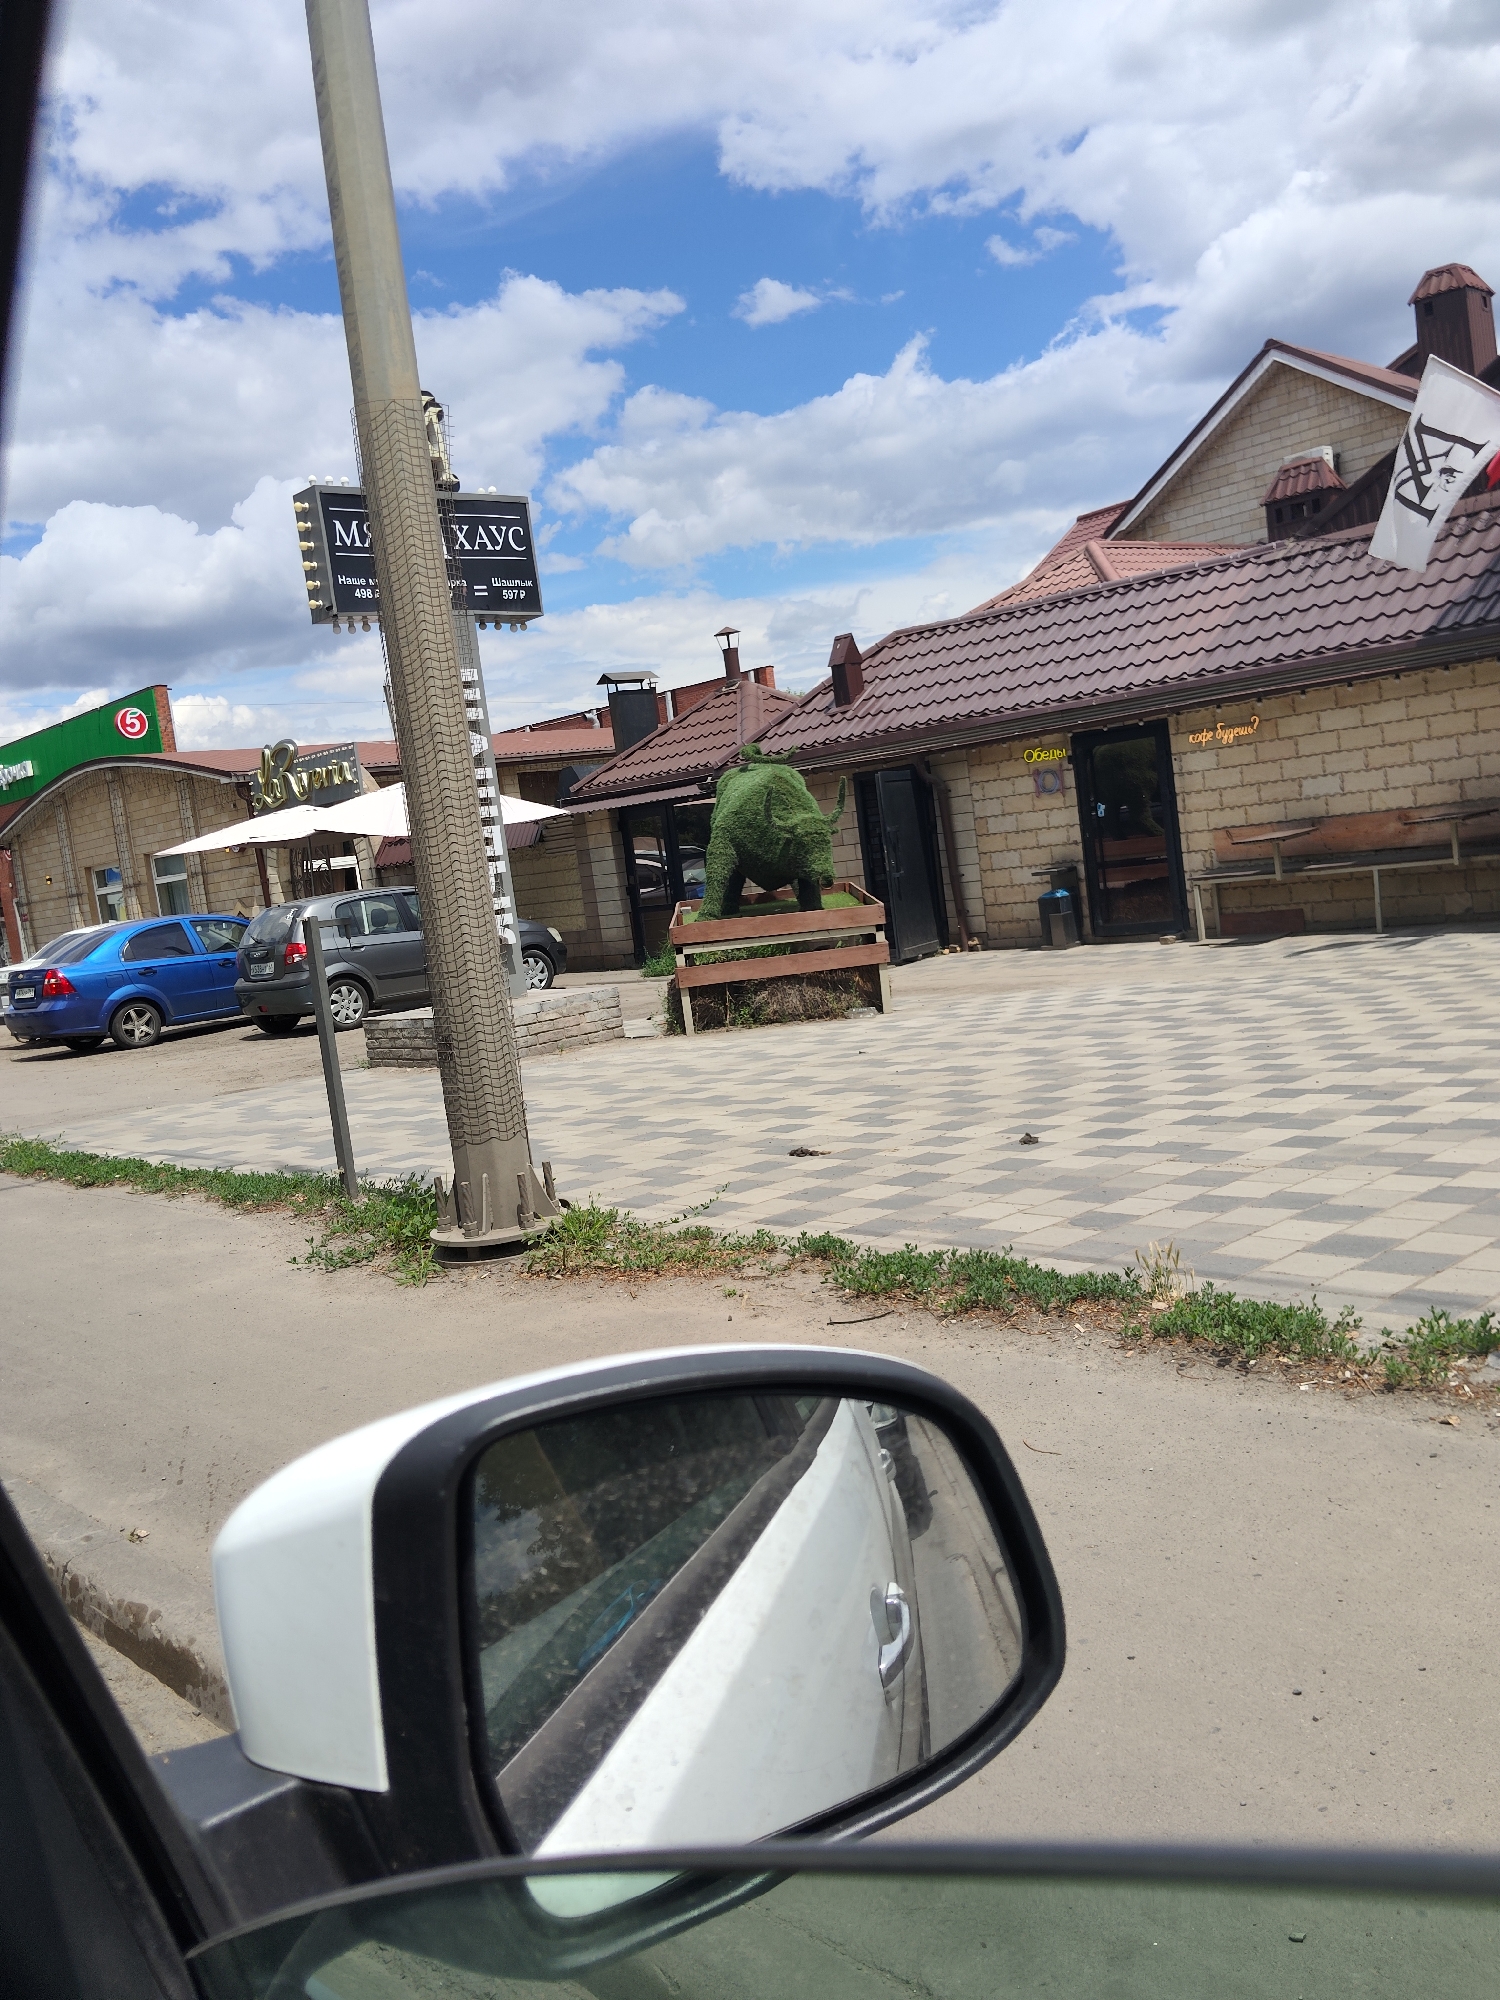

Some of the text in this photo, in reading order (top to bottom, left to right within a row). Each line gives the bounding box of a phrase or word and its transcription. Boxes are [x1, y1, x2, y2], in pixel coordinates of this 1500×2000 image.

[451, 524, 527, 551] ХАУС
[338, 574, 367, 586] Наше
[491, 577, 533, 587] Шашлык
[354, 588, 373, 599] 498
[502, 589, 518, 600] 597
[1188, 715, 1260, 748] кофе будешь?
[1023, 747, 1067, 763] Обеды
